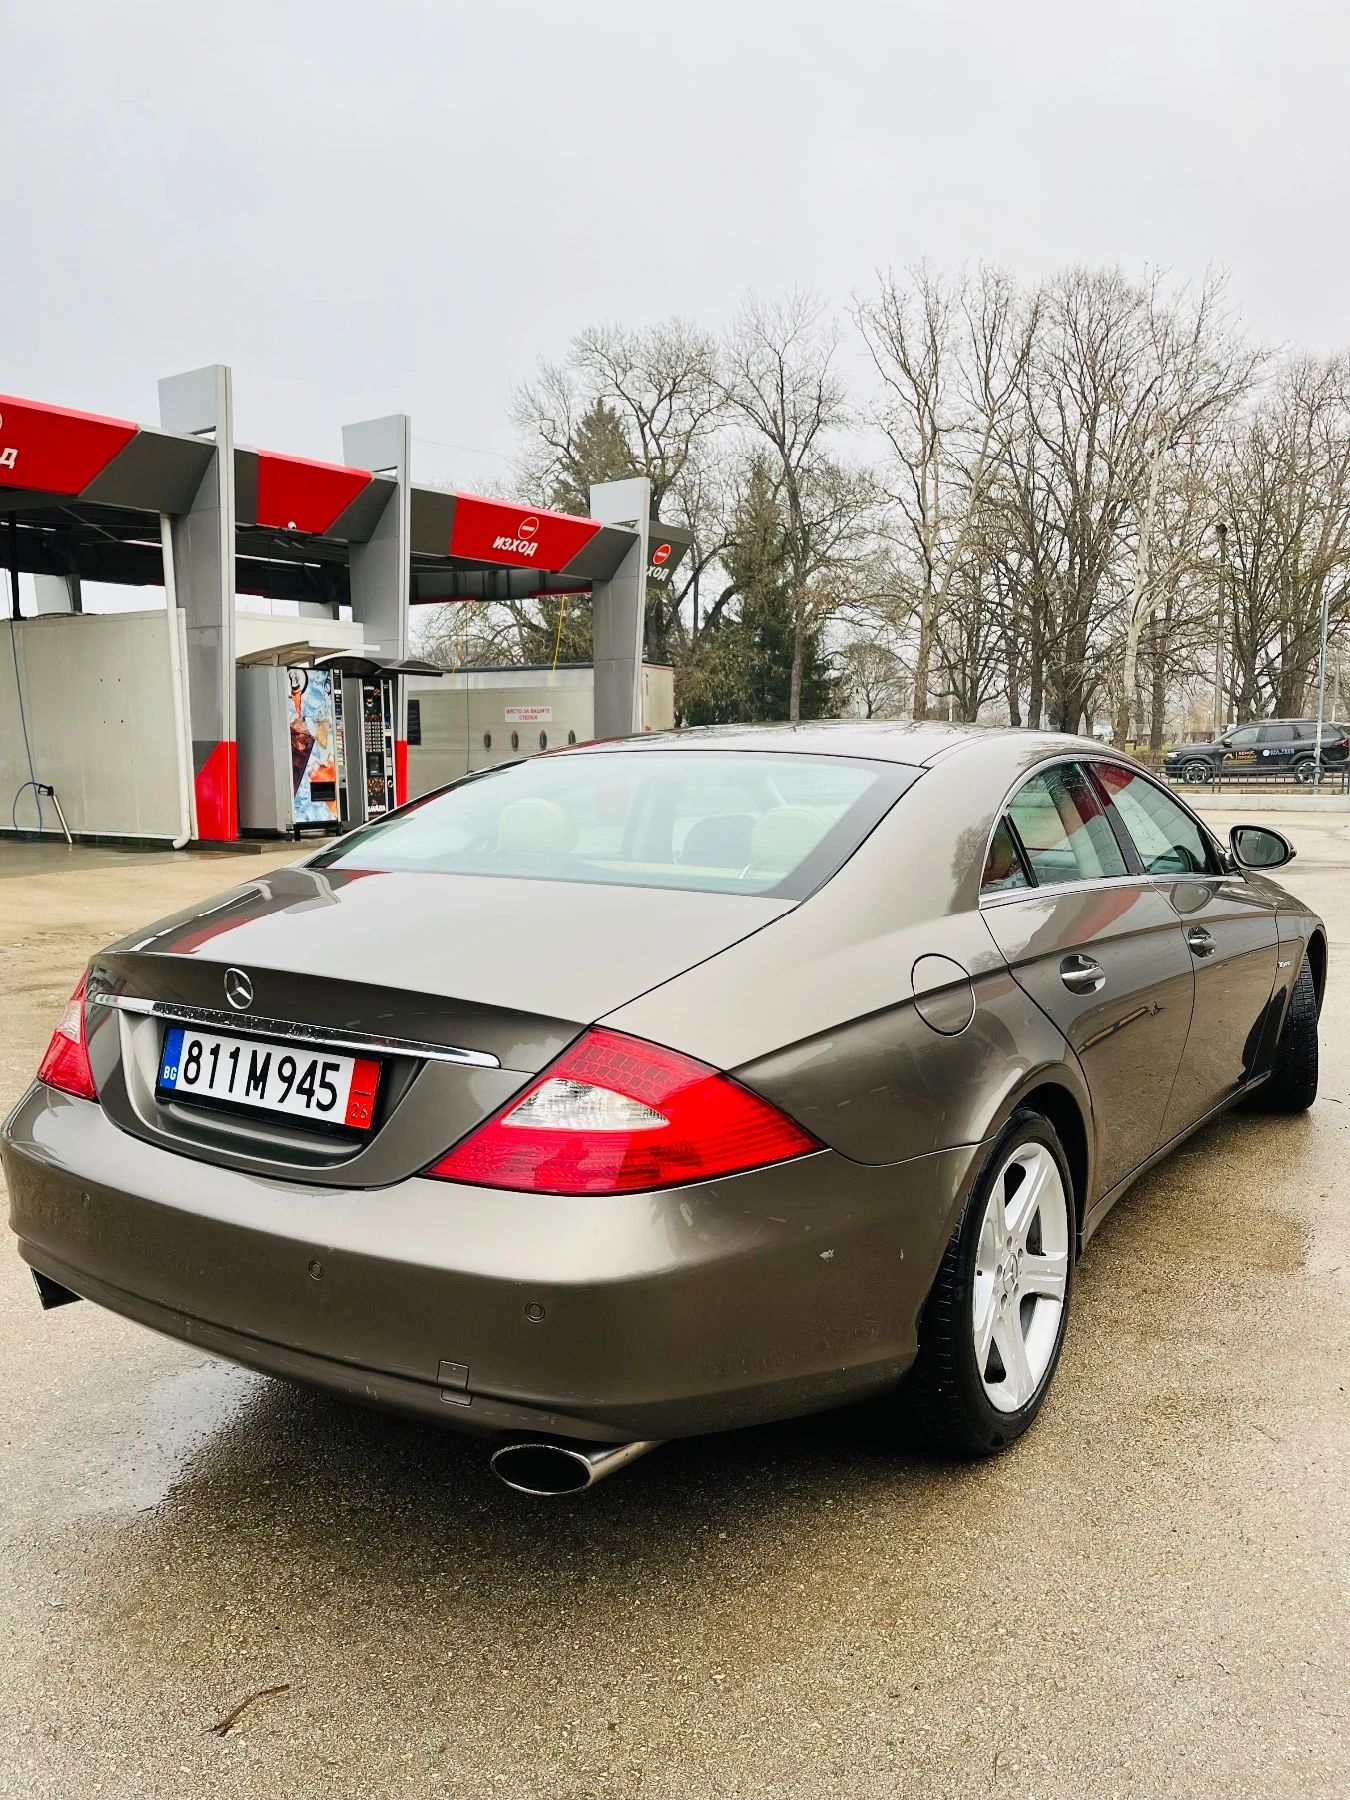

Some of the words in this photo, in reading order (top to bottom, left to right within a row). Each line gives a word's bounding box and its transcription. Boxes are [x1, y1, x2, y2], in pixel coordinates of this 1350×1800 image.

[492, 535, 539, 557] ИЗХОД
[646, 565, 670, 582] ХОД
[163, 1065, 178, 1081] BG
[183, 1039, 341, 1112] 811M945
[350, 1102, 367, 1120] 26
